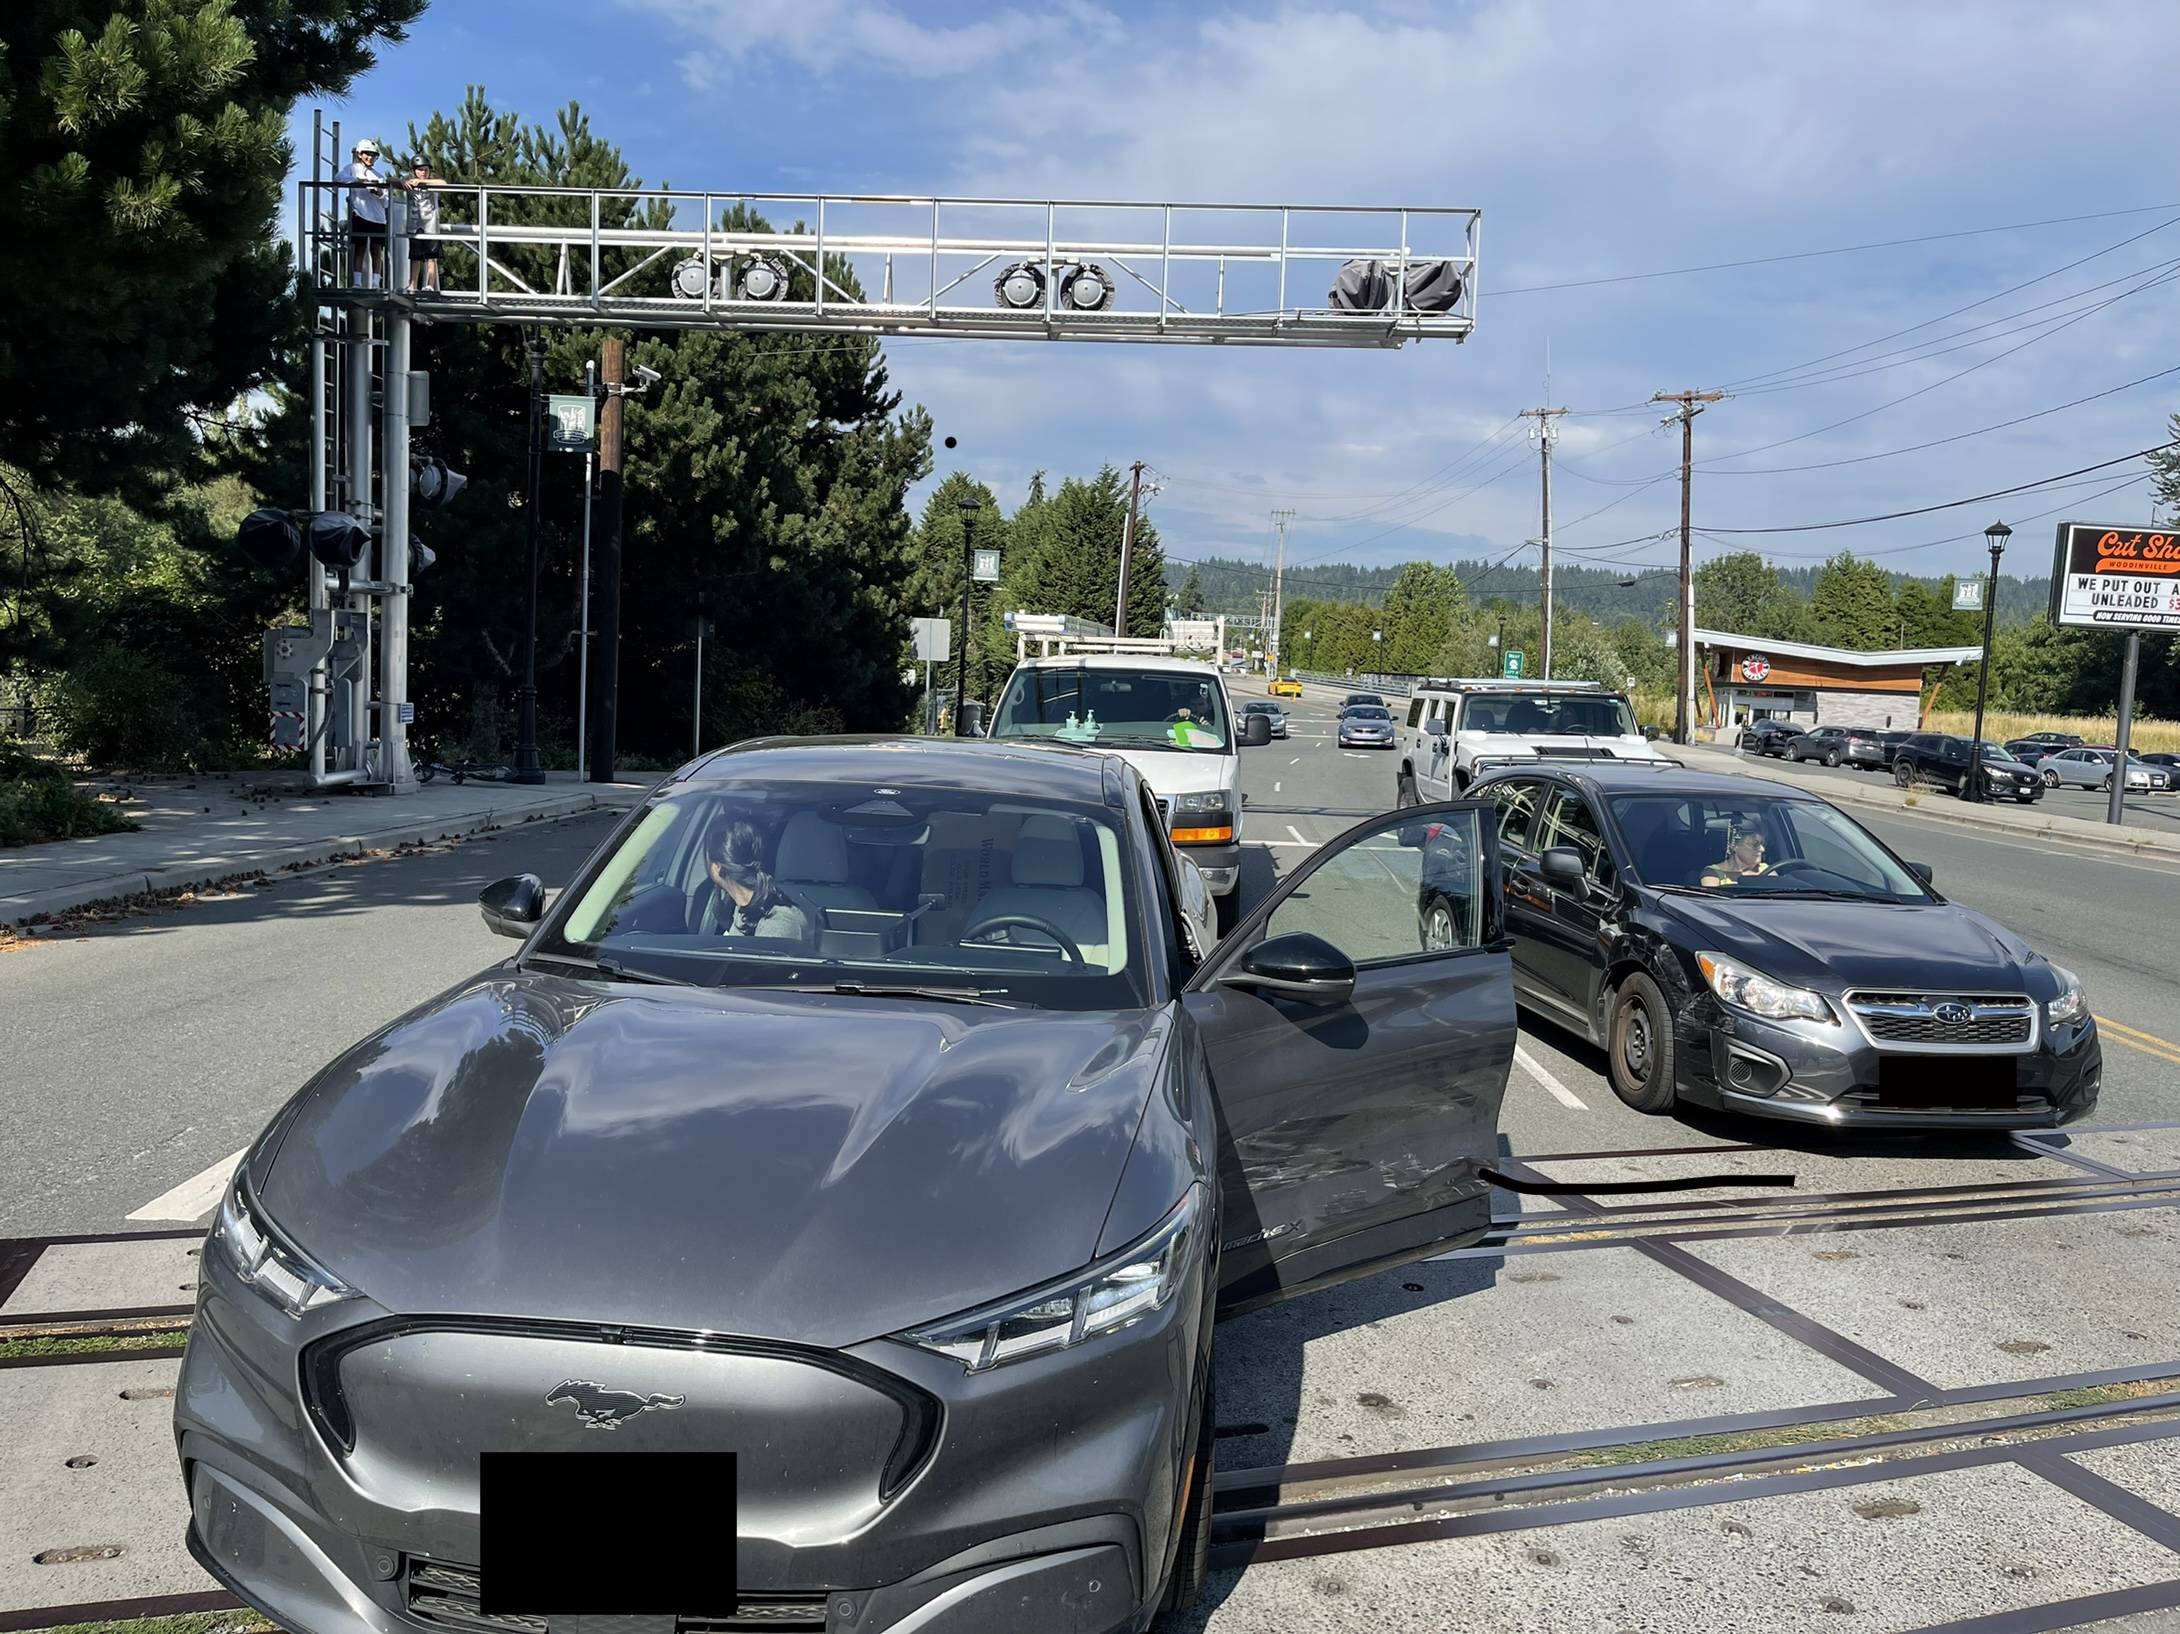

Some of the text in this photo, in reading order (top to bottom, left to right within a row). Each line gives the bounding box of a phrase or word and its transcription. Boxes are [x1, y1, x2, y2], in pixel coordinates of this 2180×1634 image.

[2097, 531, 2142, 557] Cut
[2109, 561, 2168, 571] WOODINVILLE
[2078, 577, 2096, 590] WE
[2102, 579, 2128, 592] PUT
[2134, 581, 2160, 594] OUT
[2092, 593, 2158, 608] UNLEADED
[2095, 611, 2113, 620] NOW
[2113, 612, 2142, 622] SERVING
[2142, 615, 2161, 623] GOOD
